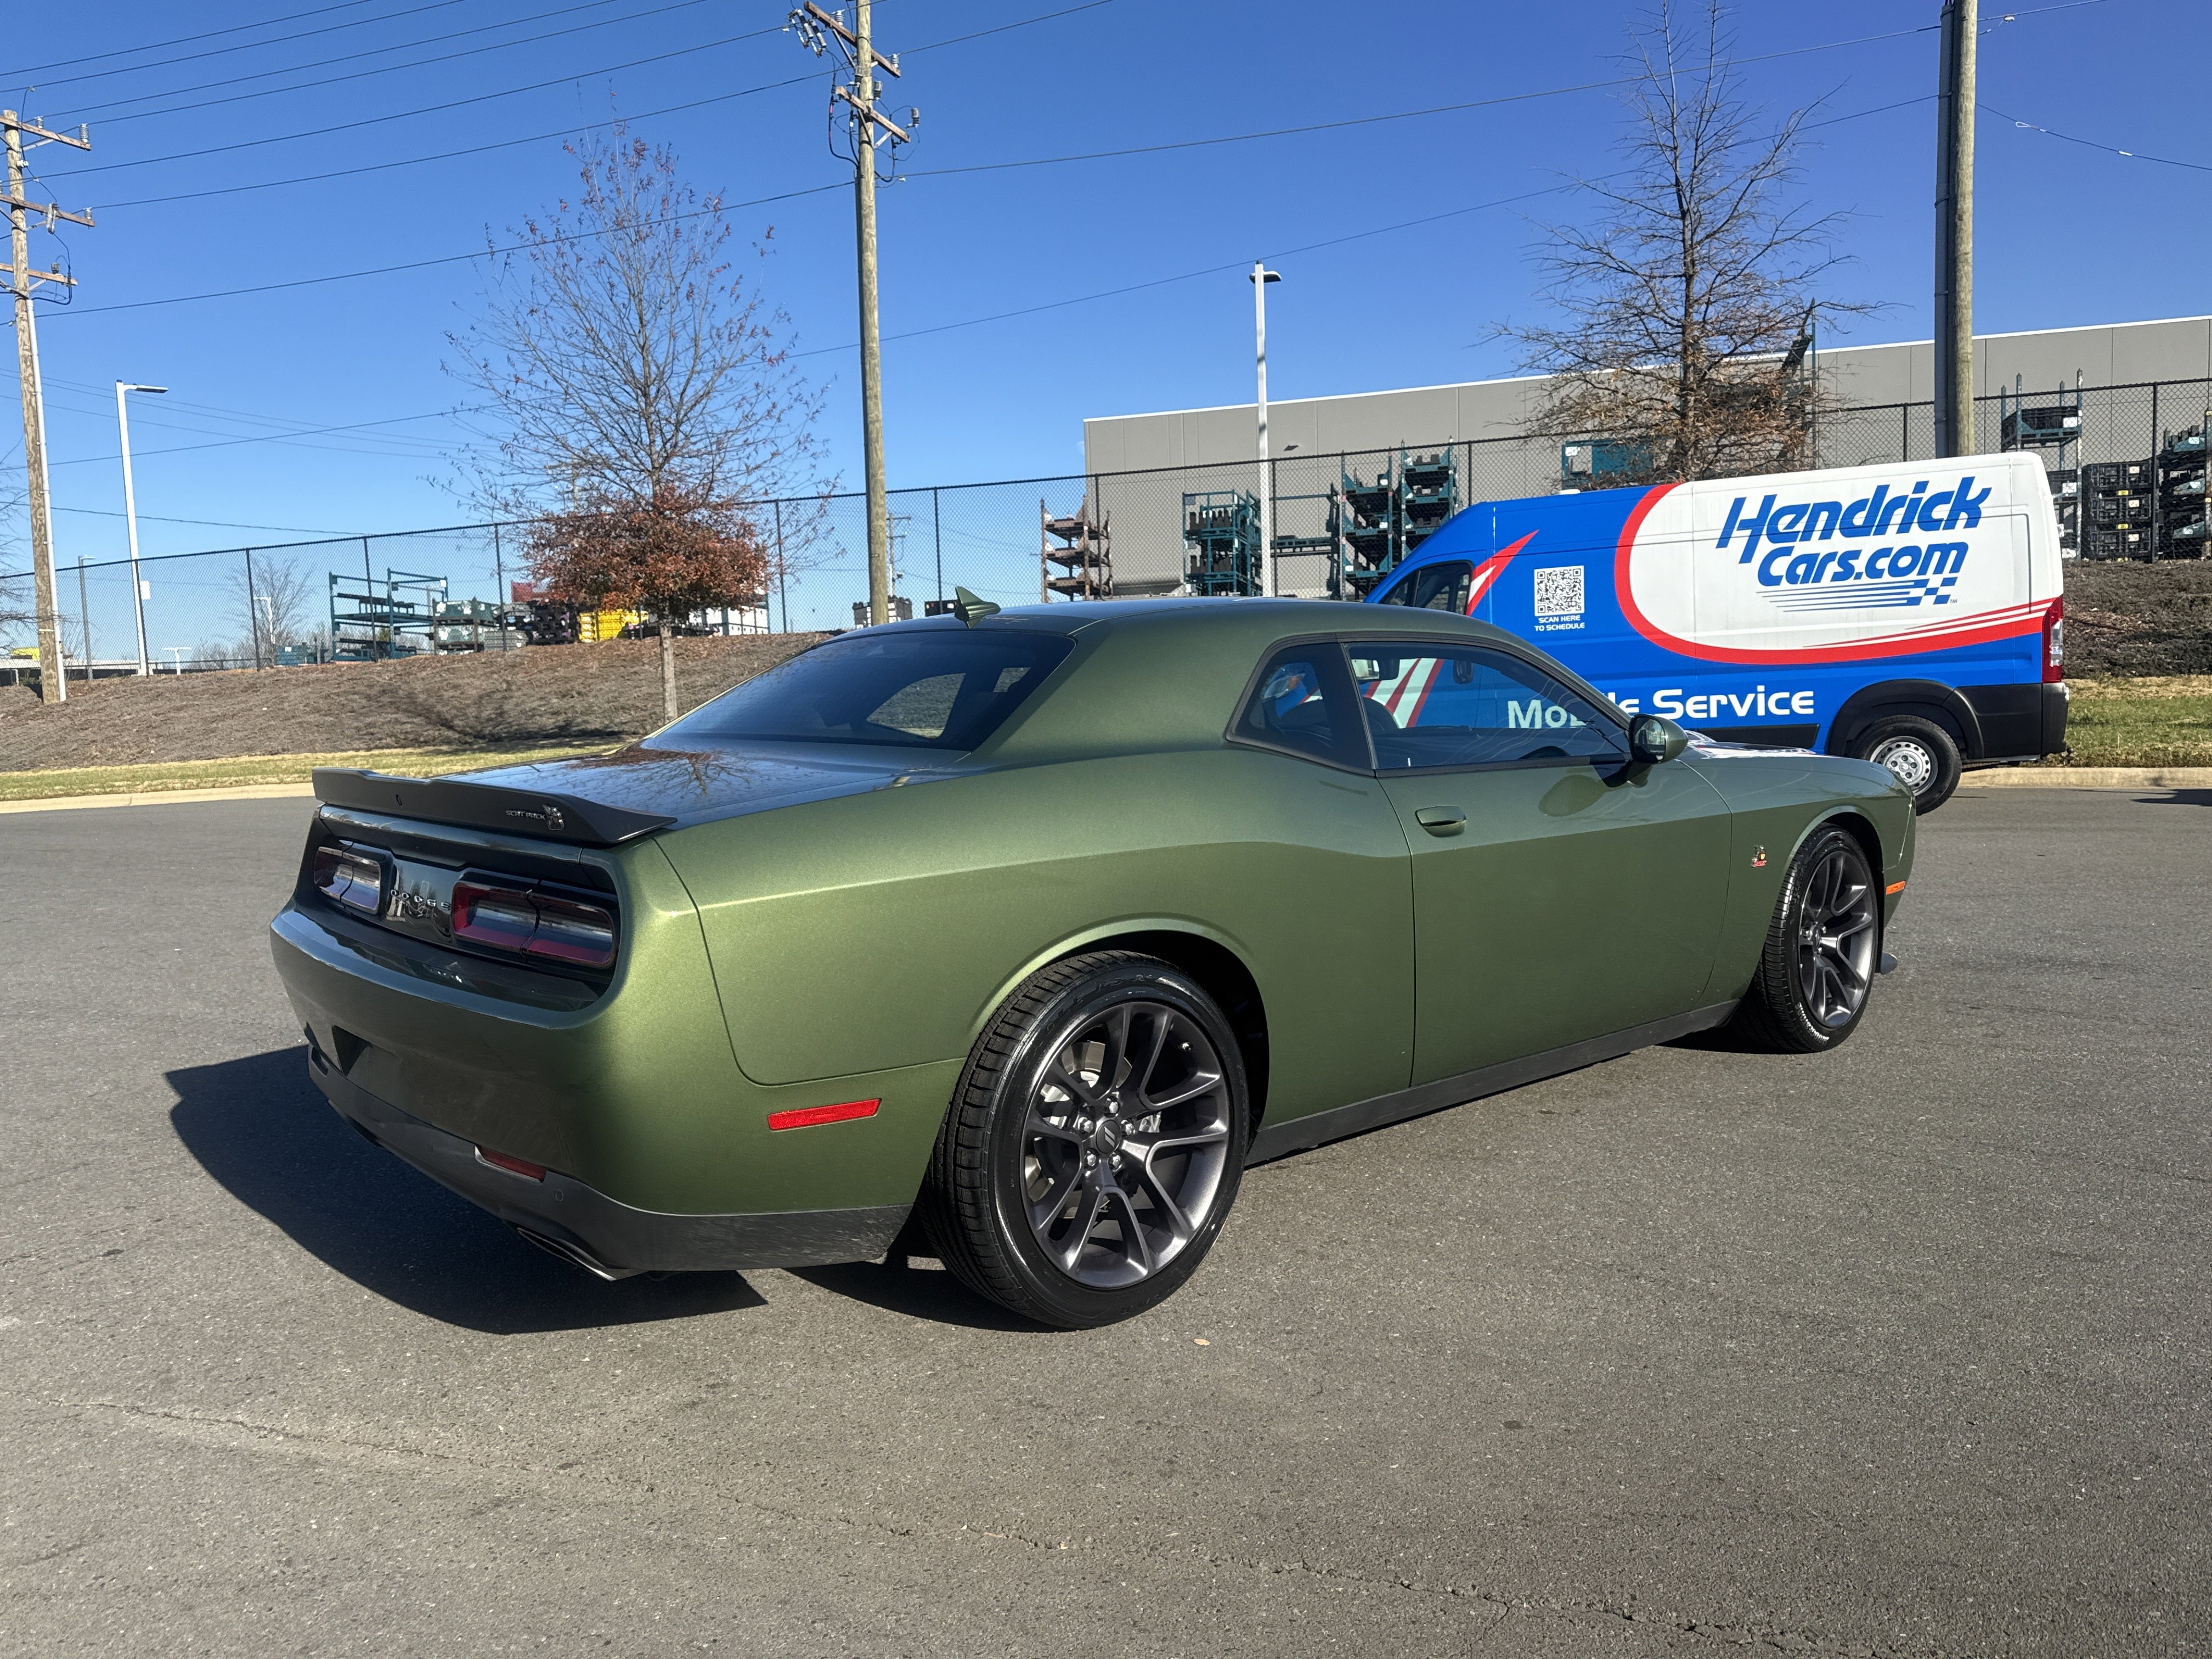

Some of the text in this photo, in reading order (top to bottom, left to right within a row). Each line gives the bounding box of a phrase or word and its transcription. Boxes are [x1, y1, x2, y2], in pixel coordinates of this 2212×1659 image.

[1715, 476, 1992, 564] Hendrick
[1757, 541, 1969, 586] Cars.com
[1546, 622, 1585, 631] SCHEDULE
[1653, 685, 1814, 720] Service
[390, 889, 452, 911] DODGE
